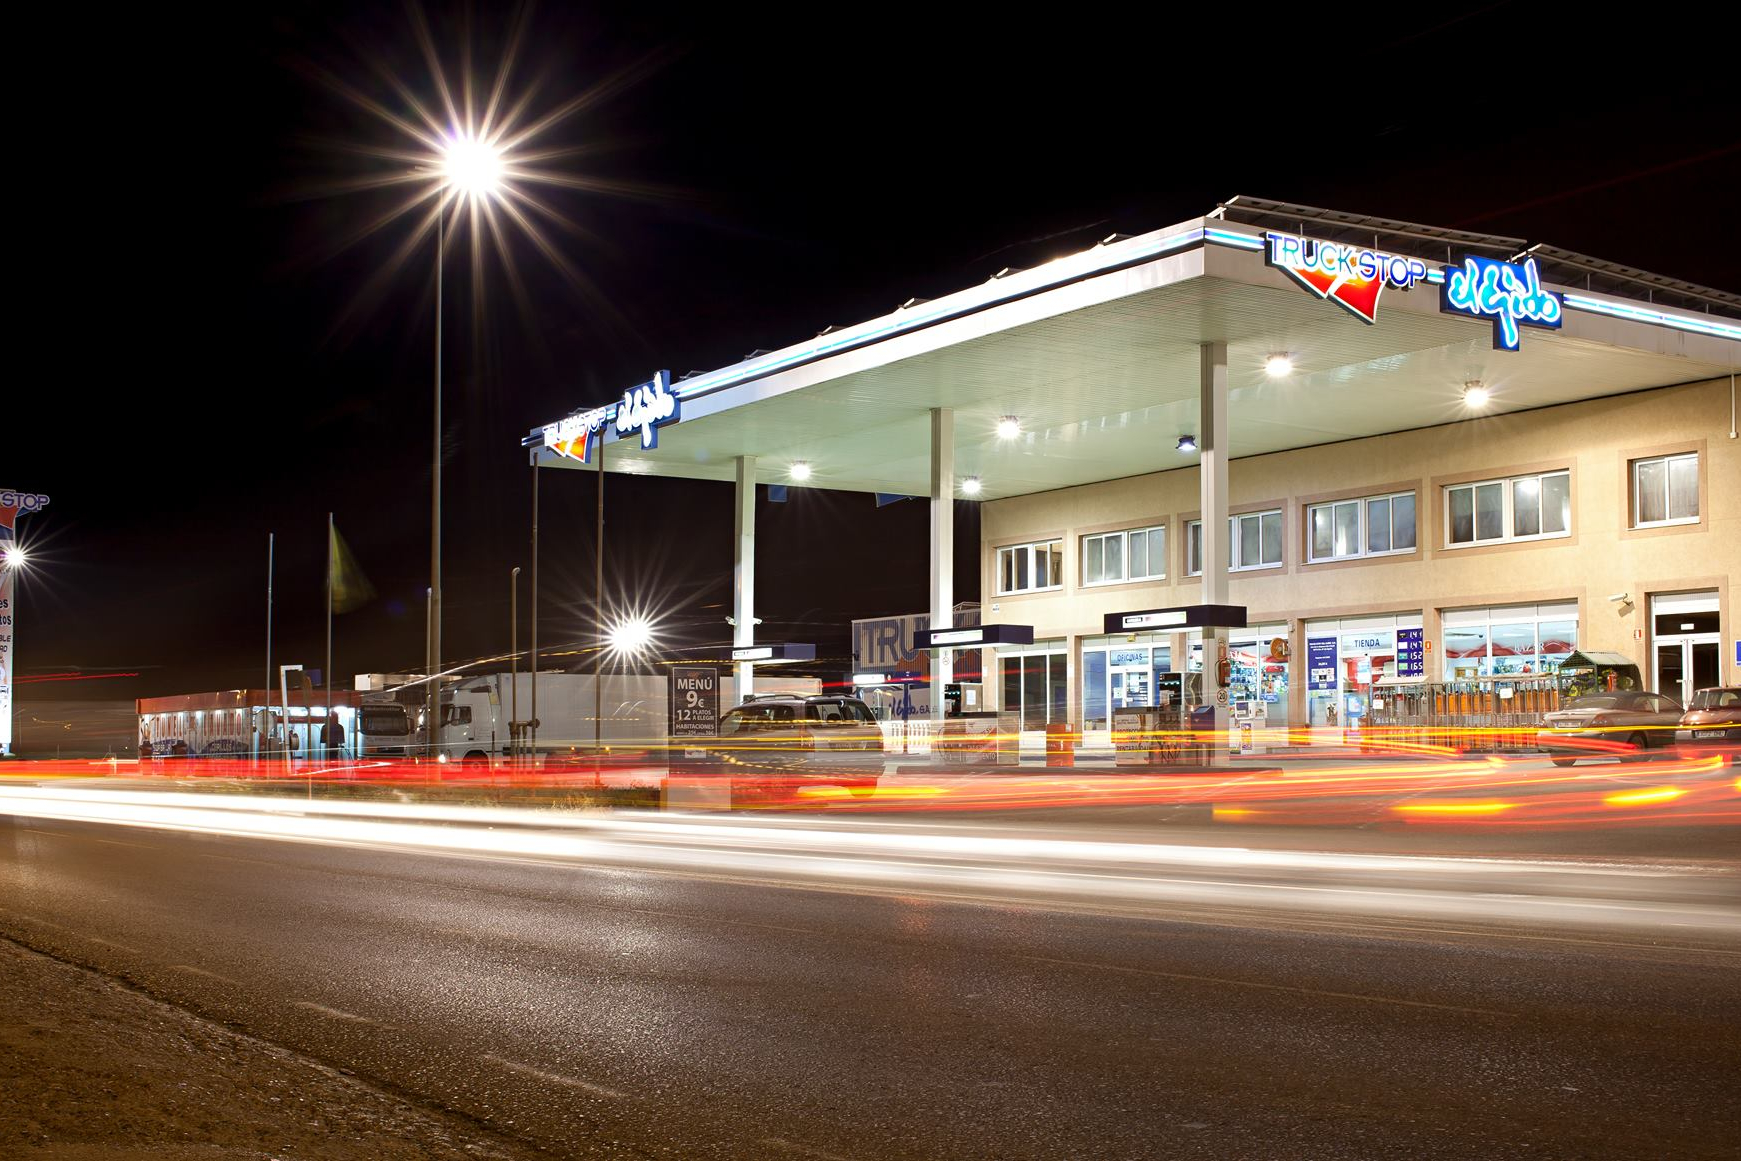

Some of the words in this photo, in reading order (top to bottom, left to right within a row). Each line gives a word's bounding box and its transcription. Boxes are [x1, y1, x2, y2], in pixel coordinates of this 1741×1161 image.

[1266, 231, 1356, 278] TRUCK
[1356, 250, 1427, 288] STOP
[2, 491, 51, 511] STOP
[1354, 638, 1381, 648] TIENDA
[677, 677, 713, 690] MENÚ
[676, 709, 691, 720] 12
[203, 712, 242, 735] LAVADO
